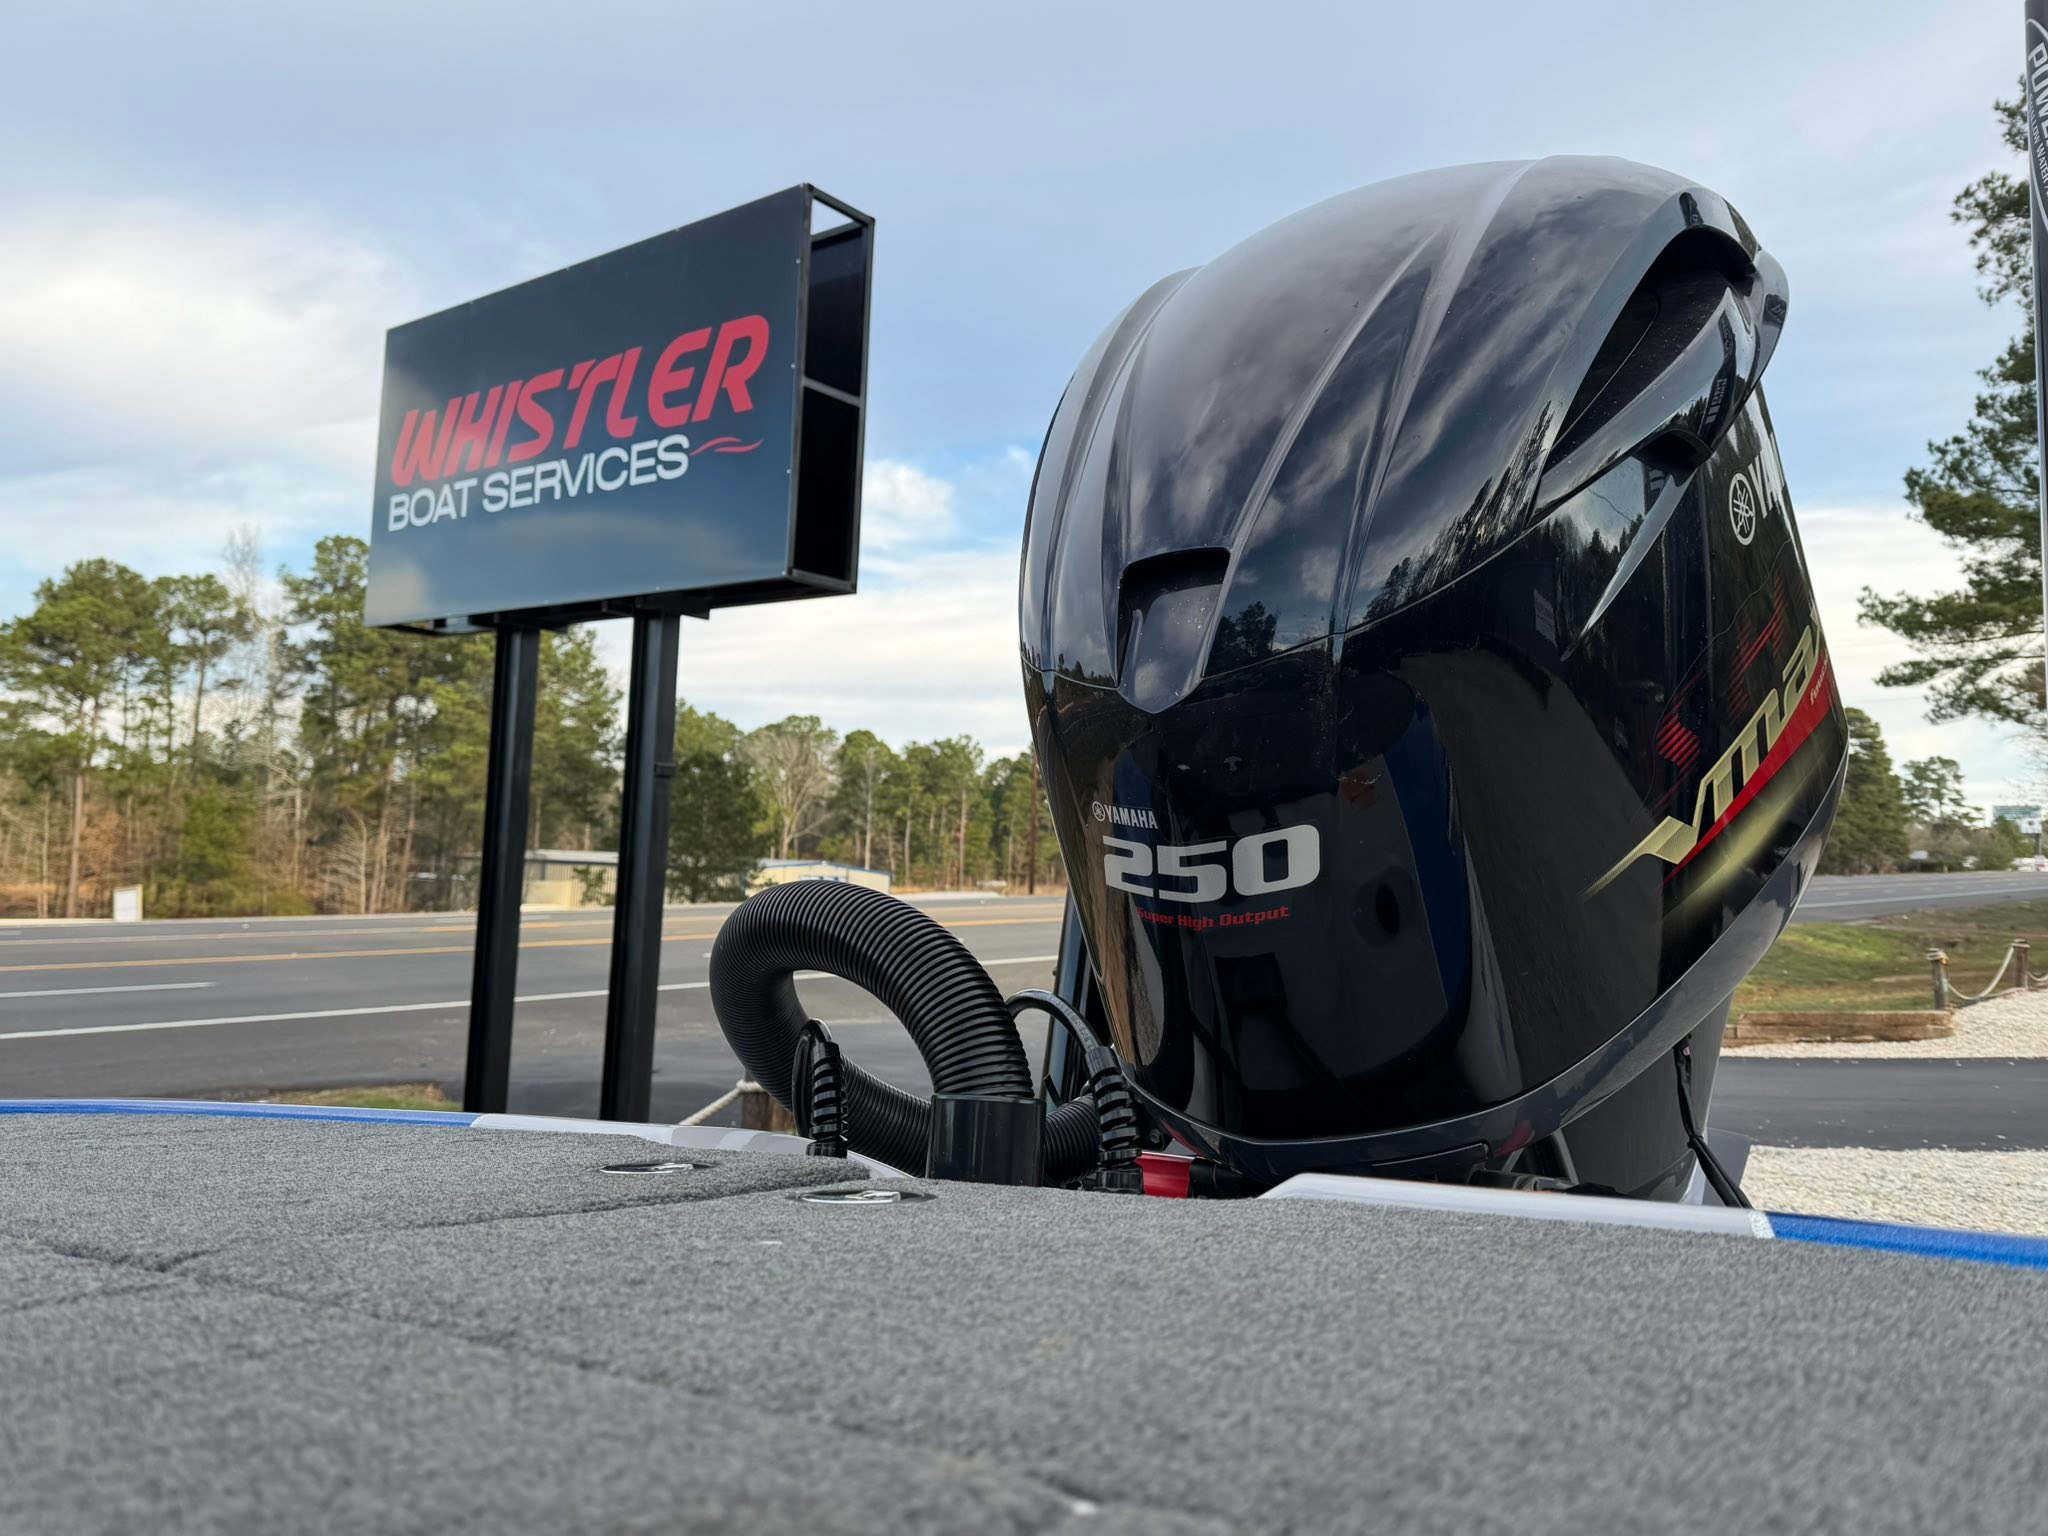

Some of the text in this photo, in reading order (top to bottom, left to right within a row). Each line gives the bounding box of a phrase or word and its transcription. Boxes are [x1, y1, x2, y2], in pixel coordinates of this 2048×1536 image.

[391, 314, 770, 486] WHISTLER
[388, 433, 690, 532] BOAT SERVICES
[1104, 804, 1158, 829] YAMAHA
[1103, 824, 1321, 903] 250
[1136, 905, 1289, 931] Super High Output
